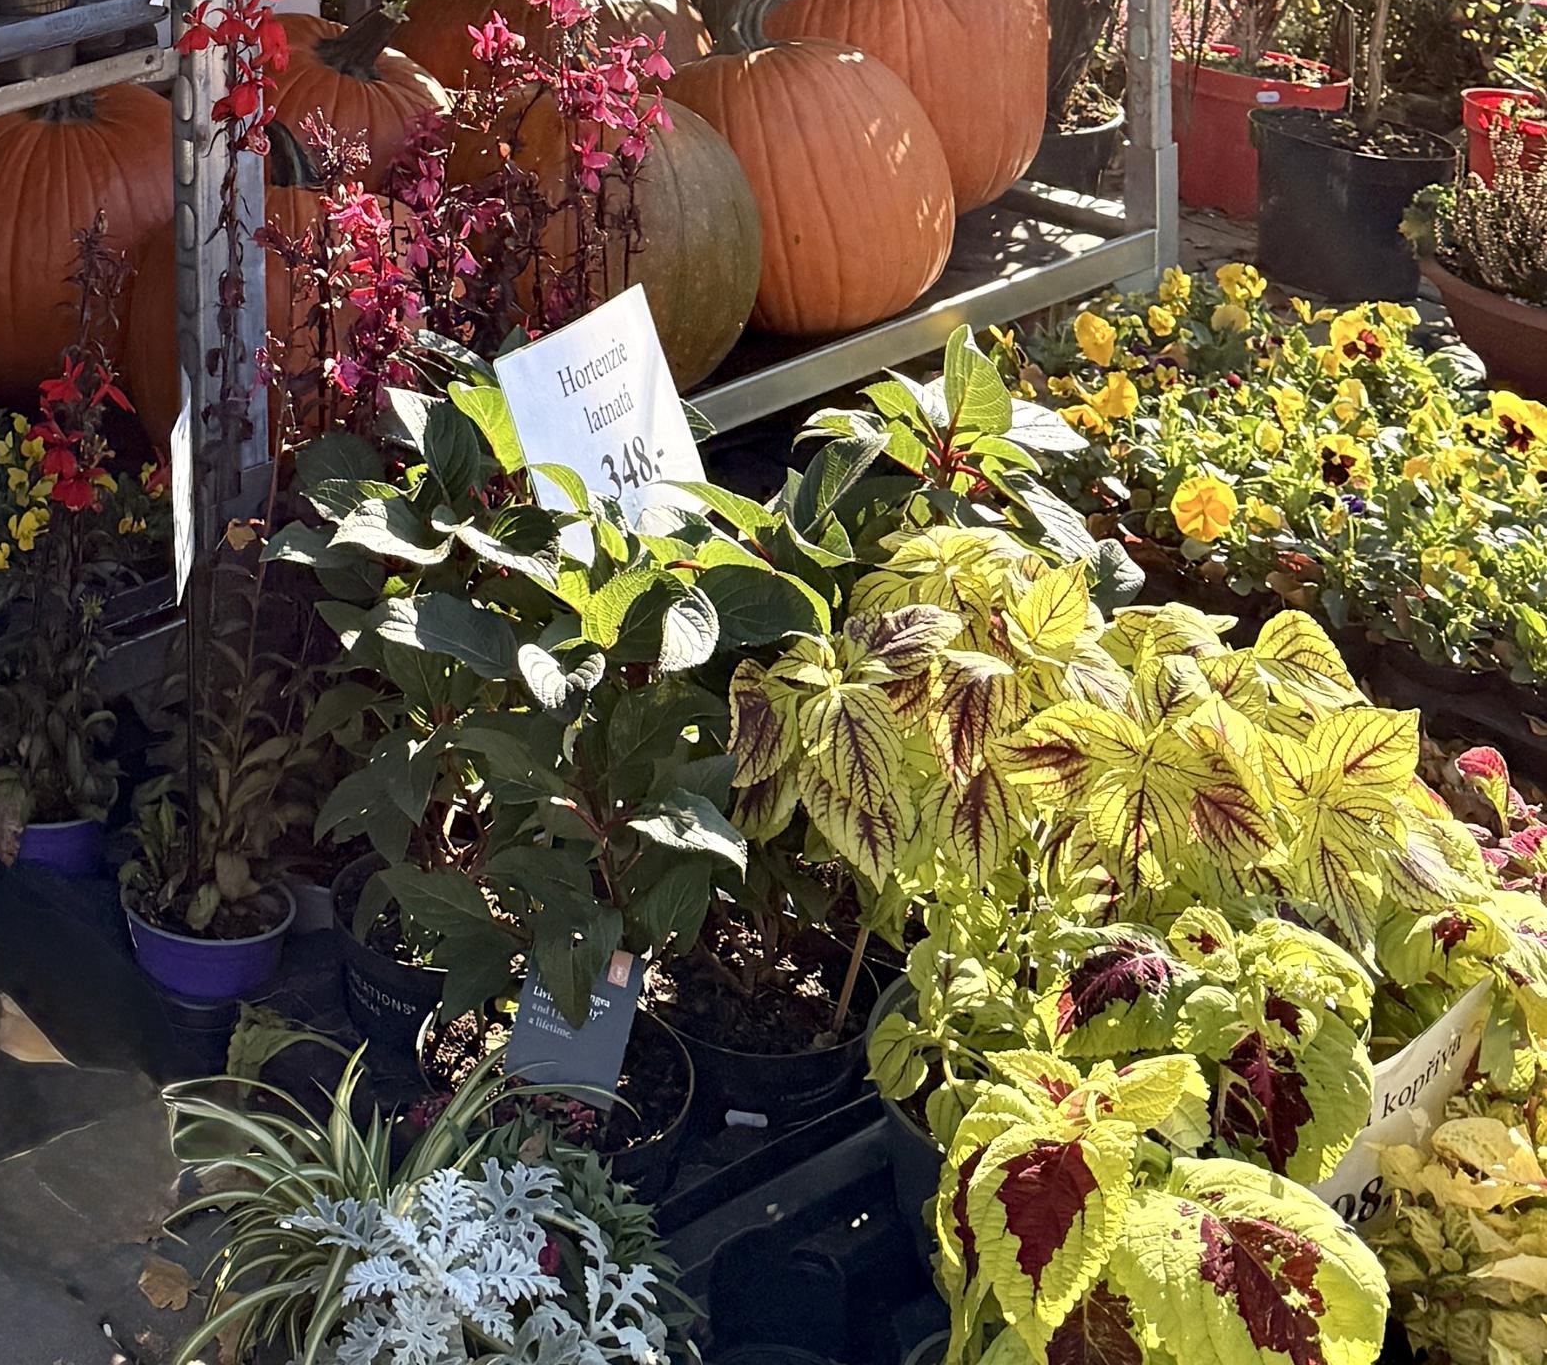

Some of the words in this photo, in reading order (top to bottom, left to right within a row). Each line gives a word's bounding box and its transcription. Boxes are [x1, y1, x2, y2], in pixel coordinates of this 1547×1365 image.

[556, 338, 628, 398] Hortenzie
[583, 383, 634, 435] latnatá
[601, 435, 665, 502] 348,-
[1381, 1034, 1462, 1120] kopřiva
